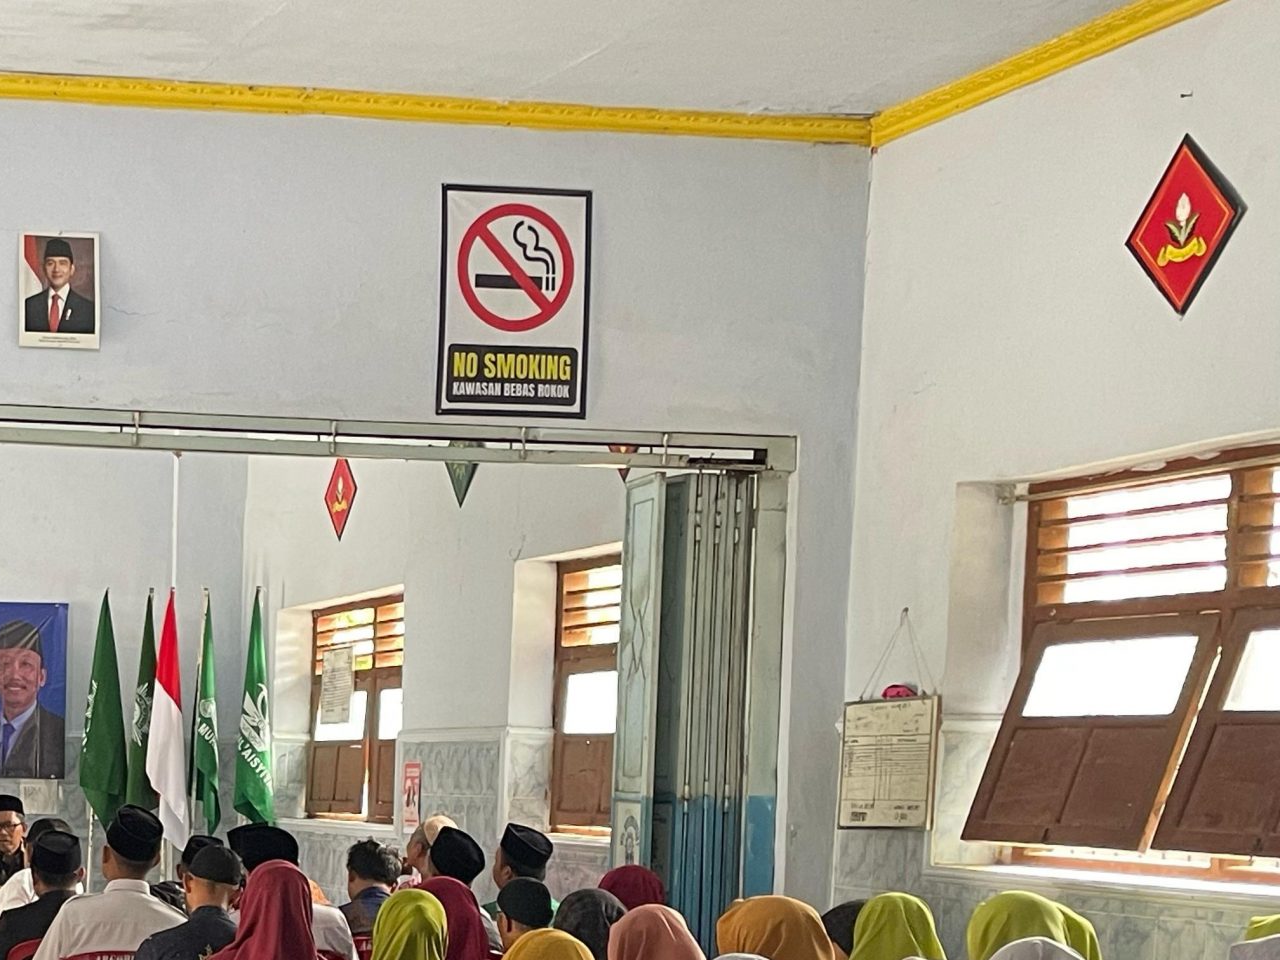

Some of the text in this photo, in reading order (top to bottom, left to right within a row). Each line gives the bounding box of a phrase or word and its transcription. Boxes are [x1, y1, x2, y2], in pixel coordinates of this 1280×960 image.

[453, 352, 571, 380] NO SMOKING
[452, 381, 570, 398] KAWASAN BEBAS ROKOK
